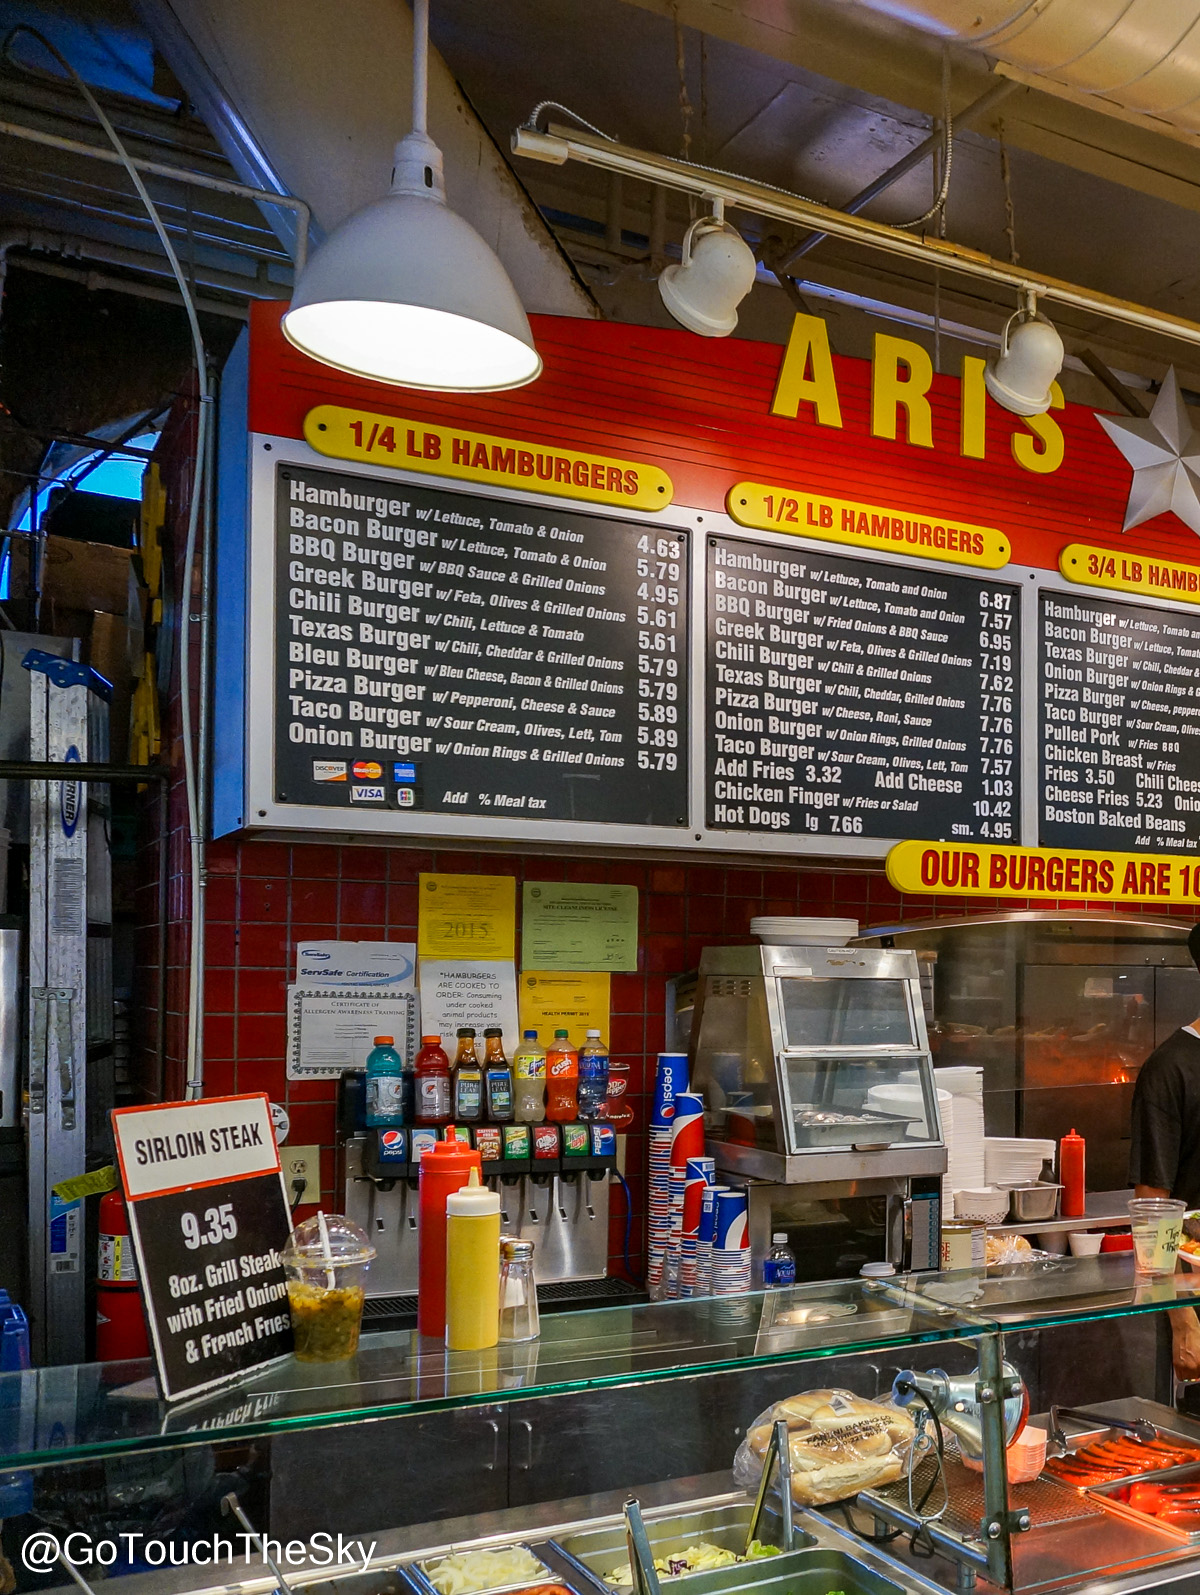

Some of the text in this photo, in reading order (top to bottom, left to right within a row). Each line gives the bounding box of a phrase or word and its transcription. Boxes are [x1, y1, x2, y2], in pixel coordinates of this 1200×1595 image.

[349, 420, 640, 497] 1/4 LB HAMBURGERS
[290, 479, 680, 559] Hamburger w/ Lettuce, Tomato & Onion 4.63
[763, 495, 985, 556] 1/2 LB HAMBURGERS
[1088, 554, 1116, 579] 3/4
[1121, 560, 1143, 582] LB
[715, 593, 1011, 651] BBQ Burger w/ Fried Onions & BBQ Sauce 6.95
[289, 668, 677, 724] Pizza Burger w/ Pepperoni, Cheese & Sauce 5.89
[1044, 723, 1087, 743] Pulled
[1090, 728, 1120, 746] Pork
[1128, 738, 1139, 749] w/
[1138, 738, 1158, 750] Fries
[65, 779, 76, 824] ERNER
[355, 788, 384, 799] VISA
[442, 791, 547, 809] Add % Meal tax
[714, 804, 744, 823] Hot
[749, 806, 790, 829] Dogs
[829, 815, 863, 834] 7.66
[951, 823, 974, 836] sm.
[979, 821, 1012, 839] 4.95
[1045, 804, 1095, 825] Boston
[1098, 809, 1141, 829] Baked
[1145, 813, 1186, 832] Beans
[920, 849, 980, 888] OUR
[989, 854, 1114, 895] BURGERS
[1121, 862, 1171, 896] ARE
[443, 921, 489, 939] 2015
[300, 968, 390, 978] ServSafe Certification
[466, 992, 502, 1000] Consuming
[551, 1057, 573, 1076] Crush
[661, 1066, 675, 1102] pepsi
[135, 1122, 263, 1165] SIRLOIN STEAK
[383, 1147, 403, 1157] pepsi
[592, 1126, 602, 1155] PEPSI
[181, 1202, 238, 1250] 9.35
[168, 1248, 282, 1299] 8oz. Grill Steak
[167, 1280, 289, 1334] with Fried Onion
[185, 1312, 291, 1364] & French Fries
